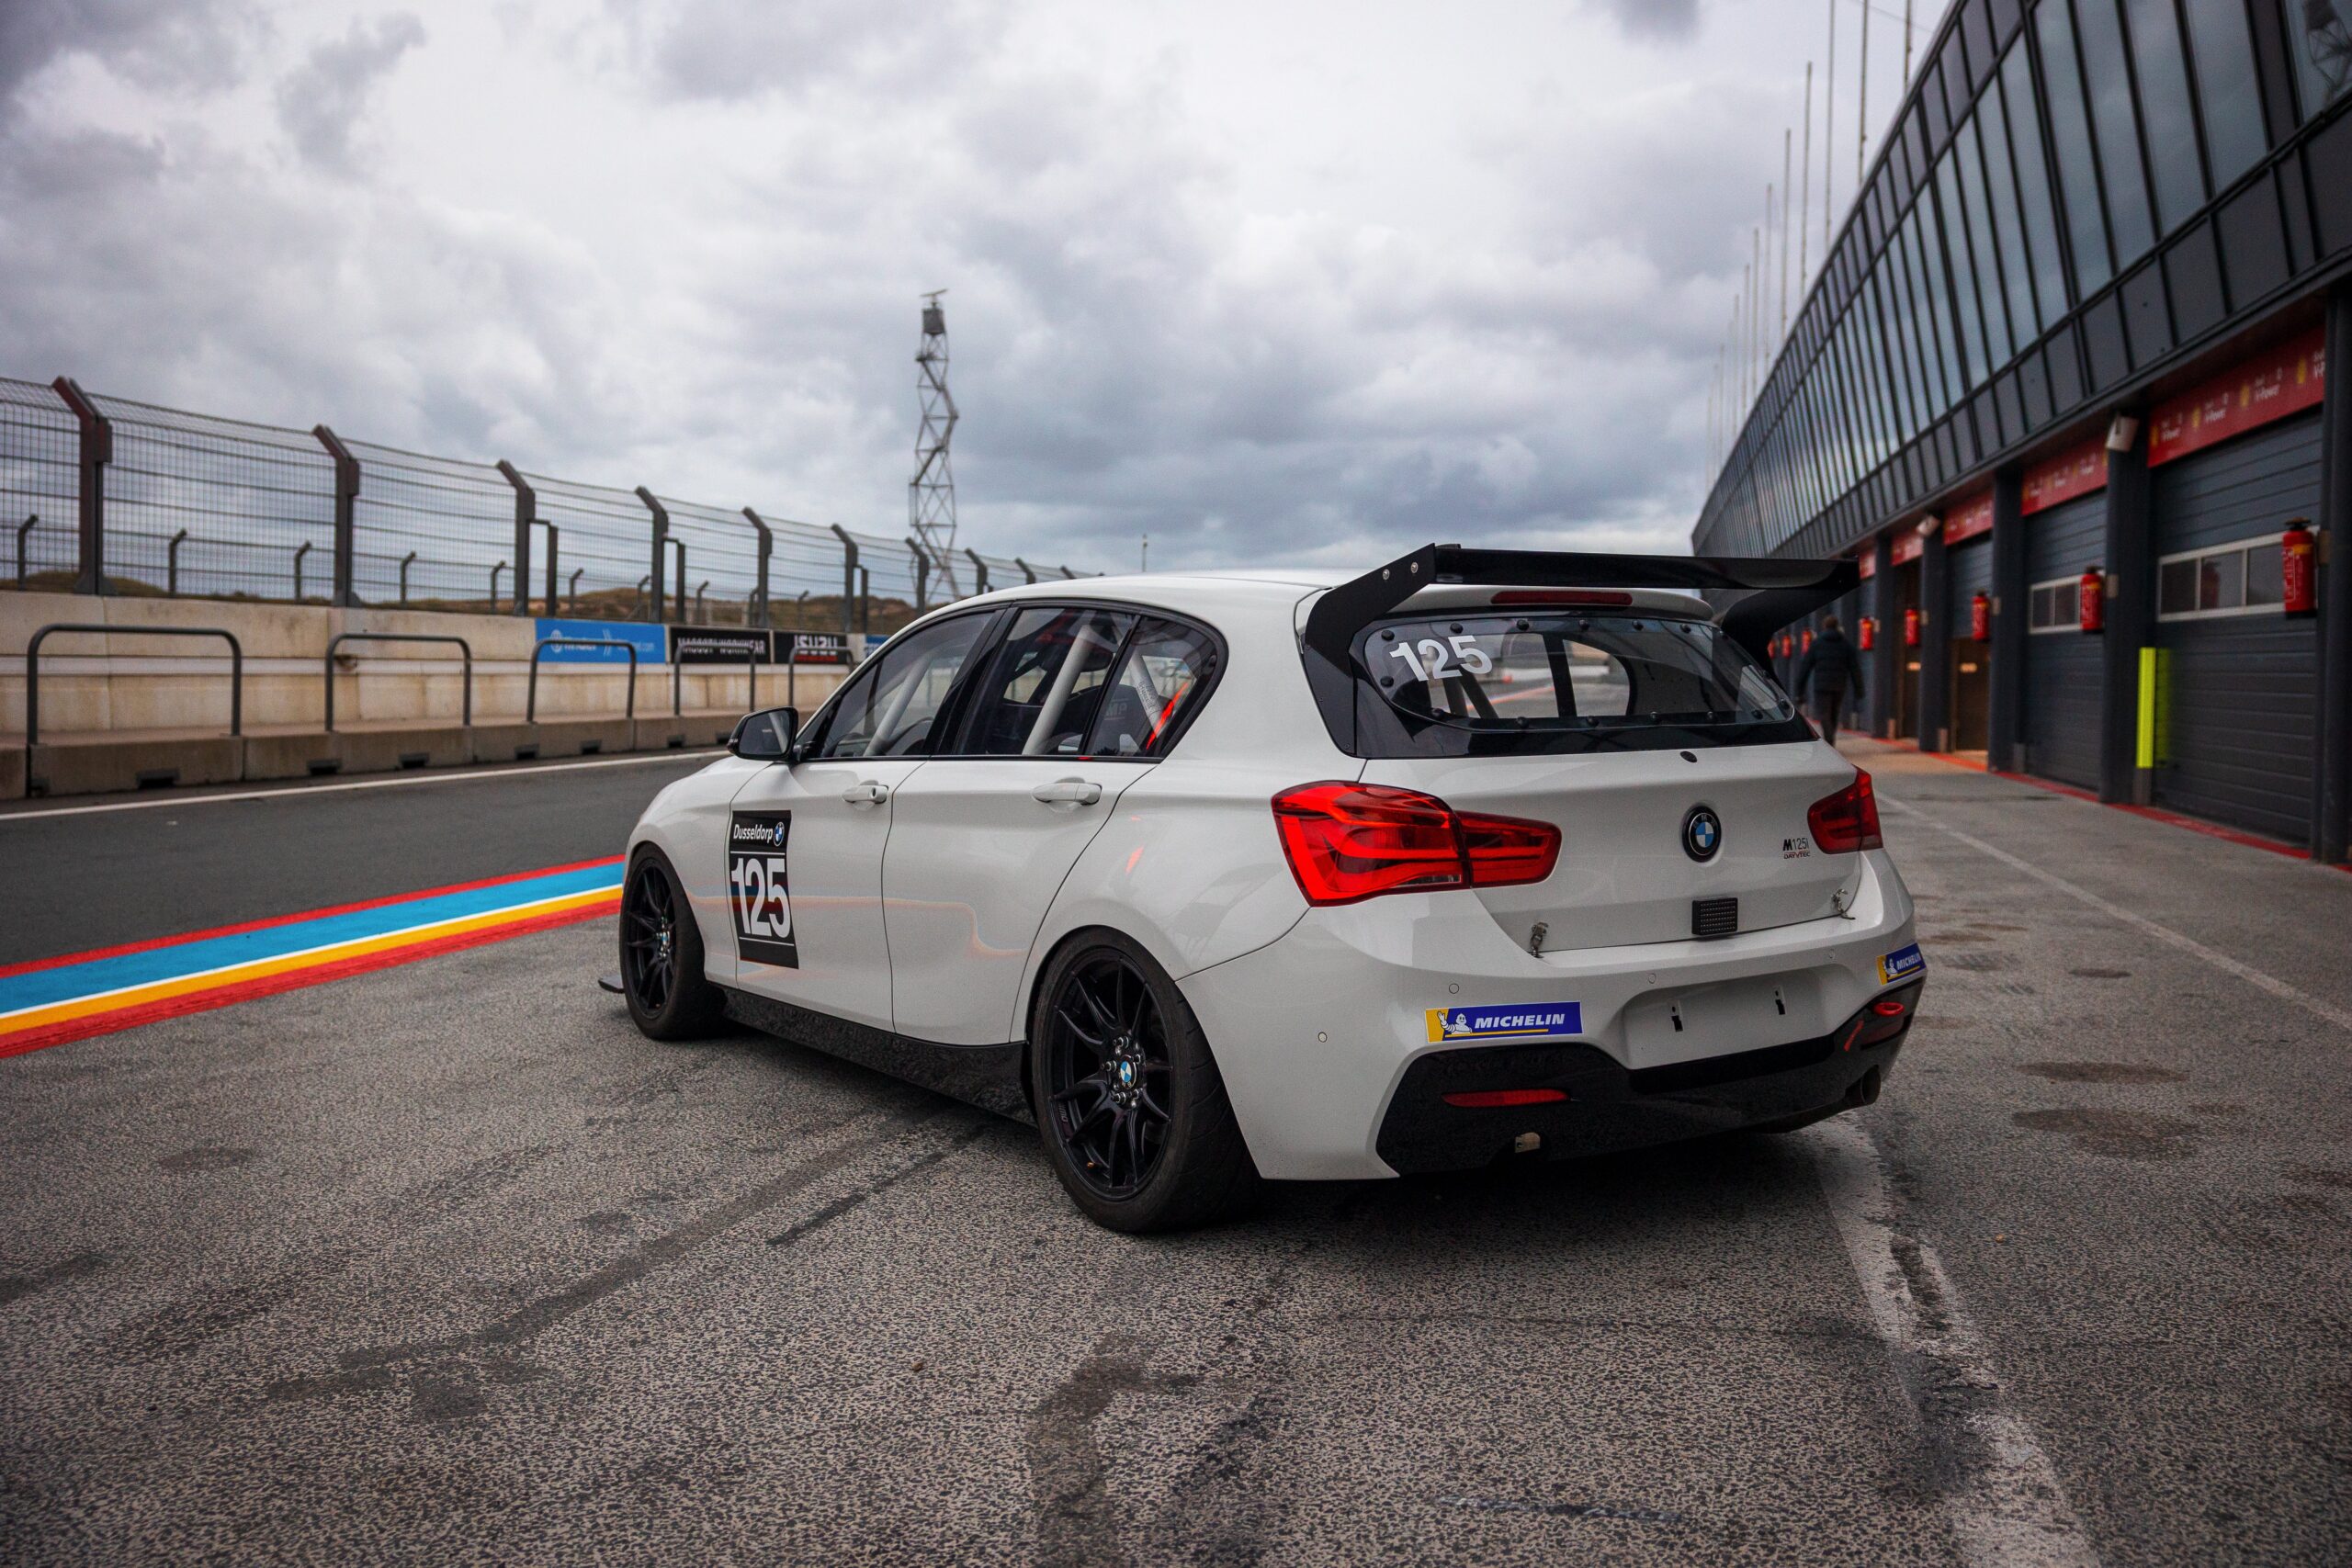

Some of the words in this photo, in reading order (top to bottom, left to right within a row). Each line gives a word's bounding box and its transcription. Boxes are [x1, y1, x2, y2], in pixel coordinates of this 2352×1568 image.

[794, 635, 838, 655] ISUZU
[1389, 635, 1493, 682] 125
[733, 824, 774, 844] Dusseldorp
[731, 857, 791, 939] 125
[1475, 1013, 1566, 1029] MICHELIN
